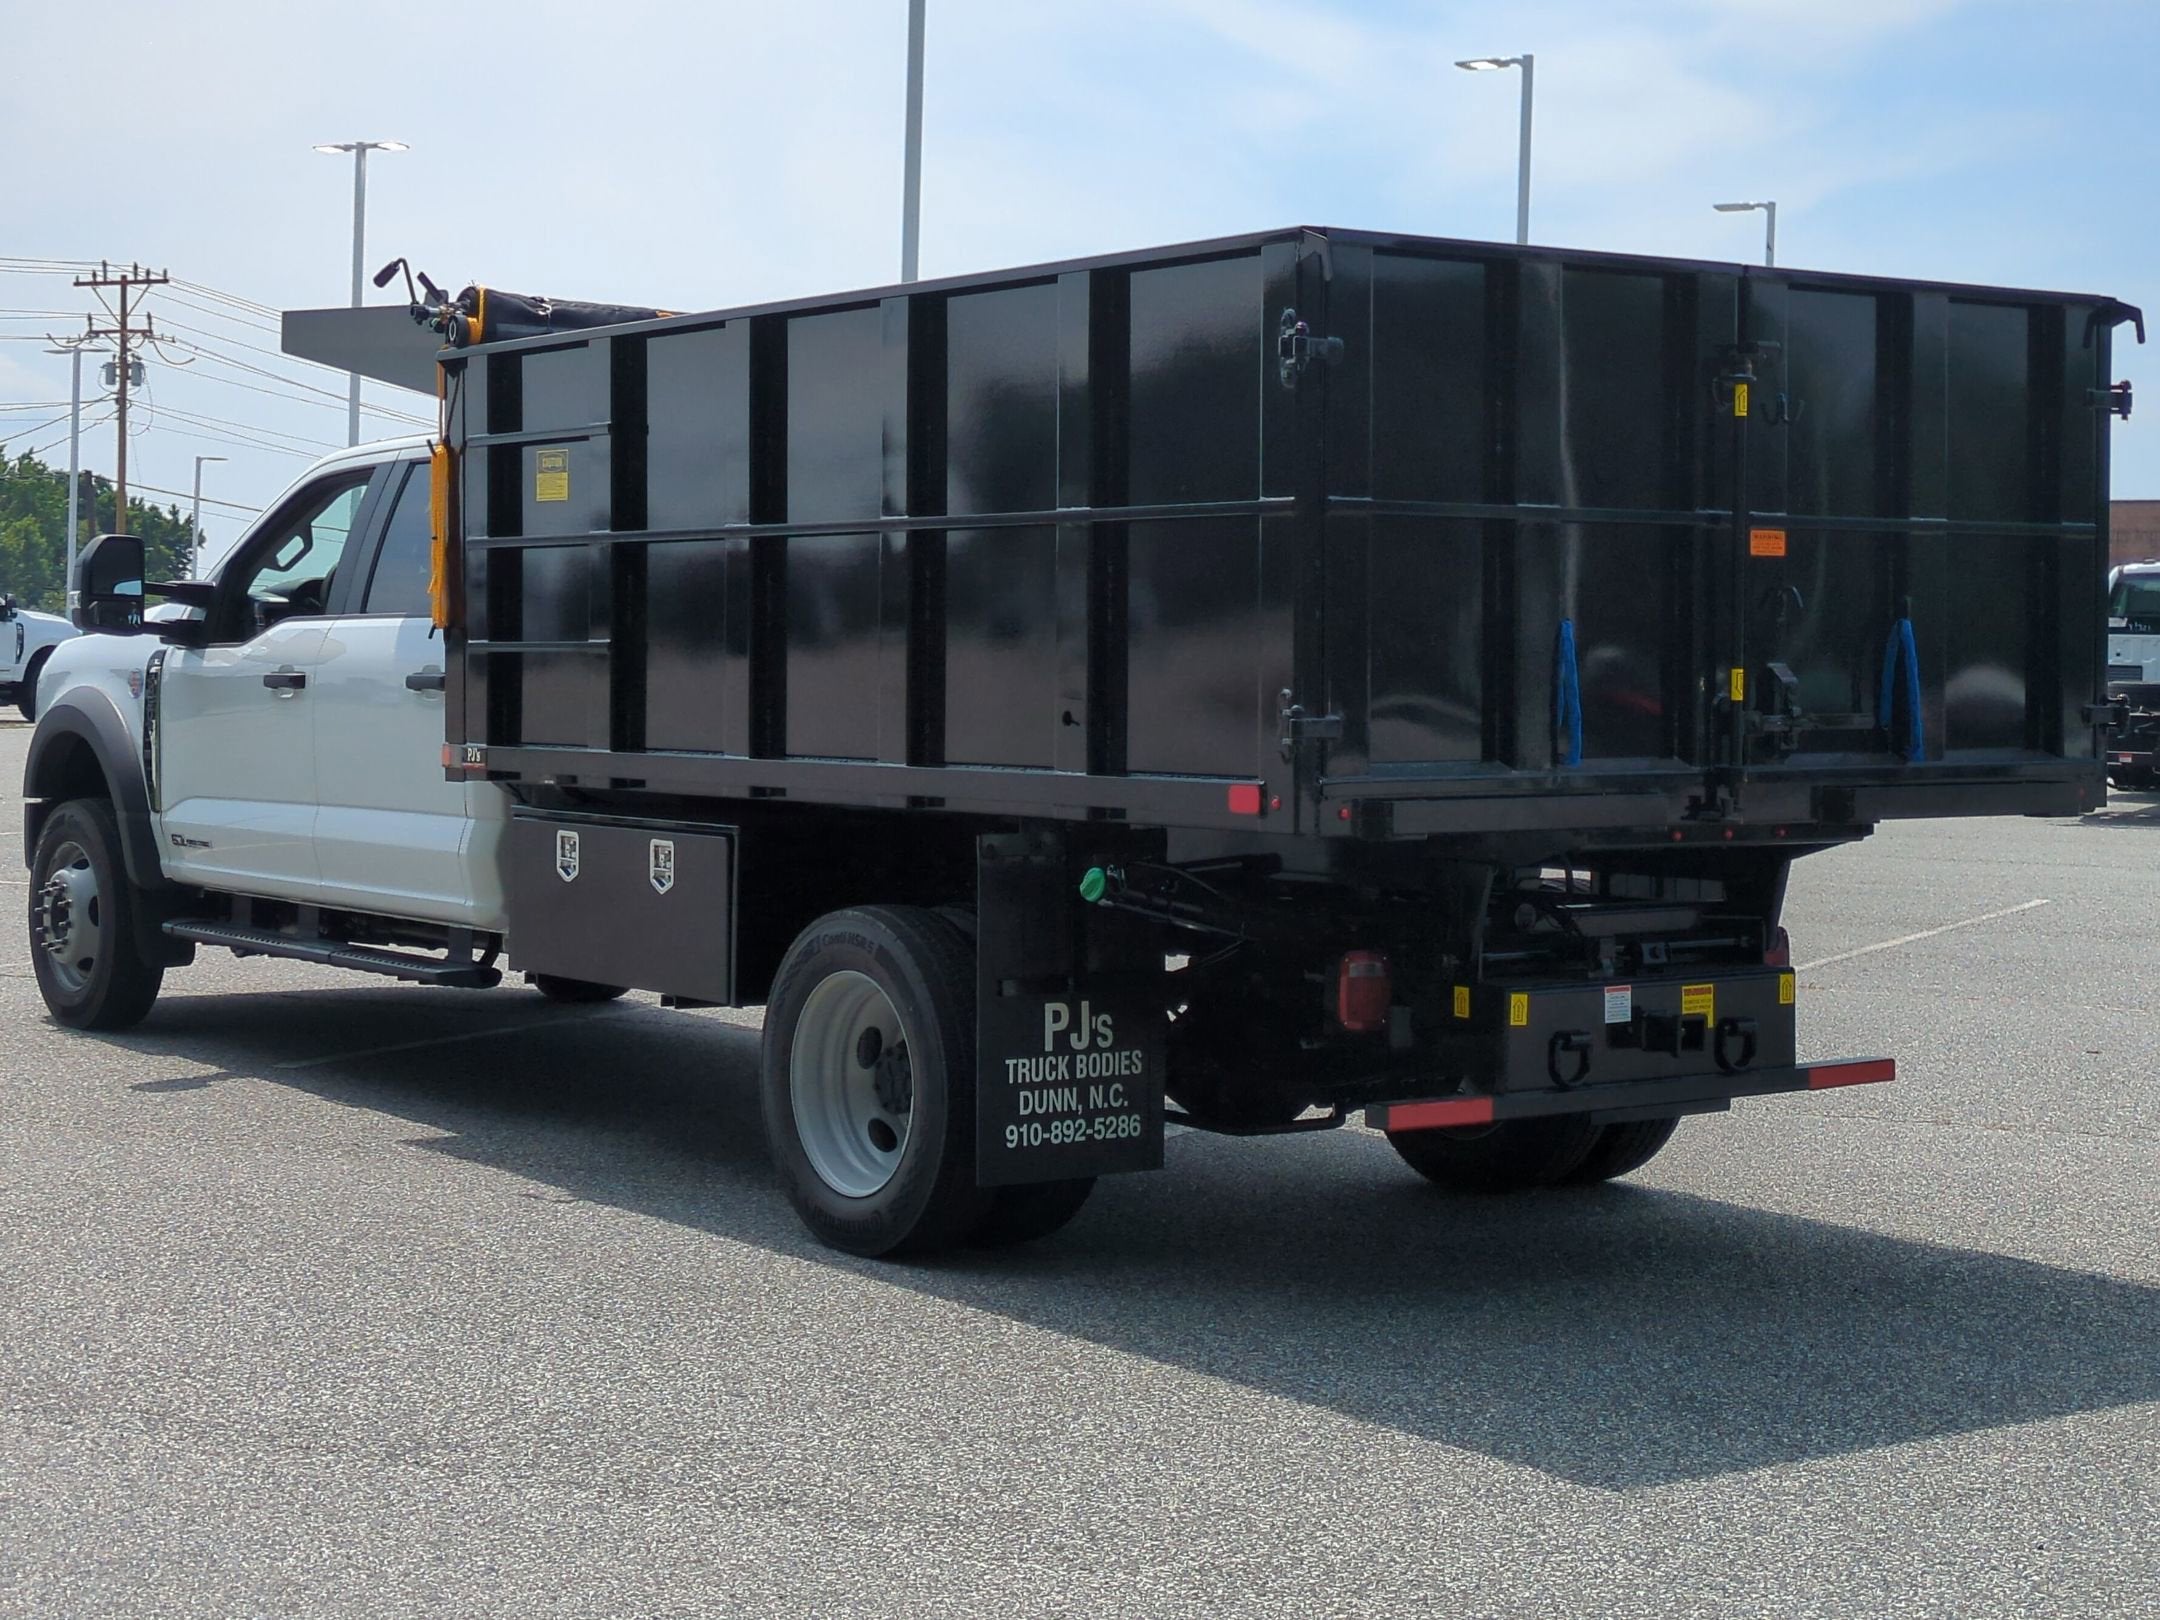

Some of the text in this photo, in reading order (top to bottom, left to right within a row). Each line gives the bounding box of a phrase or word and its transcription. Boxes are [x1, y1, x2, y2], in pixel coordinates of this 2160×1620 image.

[467, 747, 481, 762] PJ's
[1005, 1049, 1143, 1084] TRUCK BODIES
[1019, 1083, 1129, 1115] DUNN, N.C.
[1005, 1114, 1142, 1149] 910-892-5286
